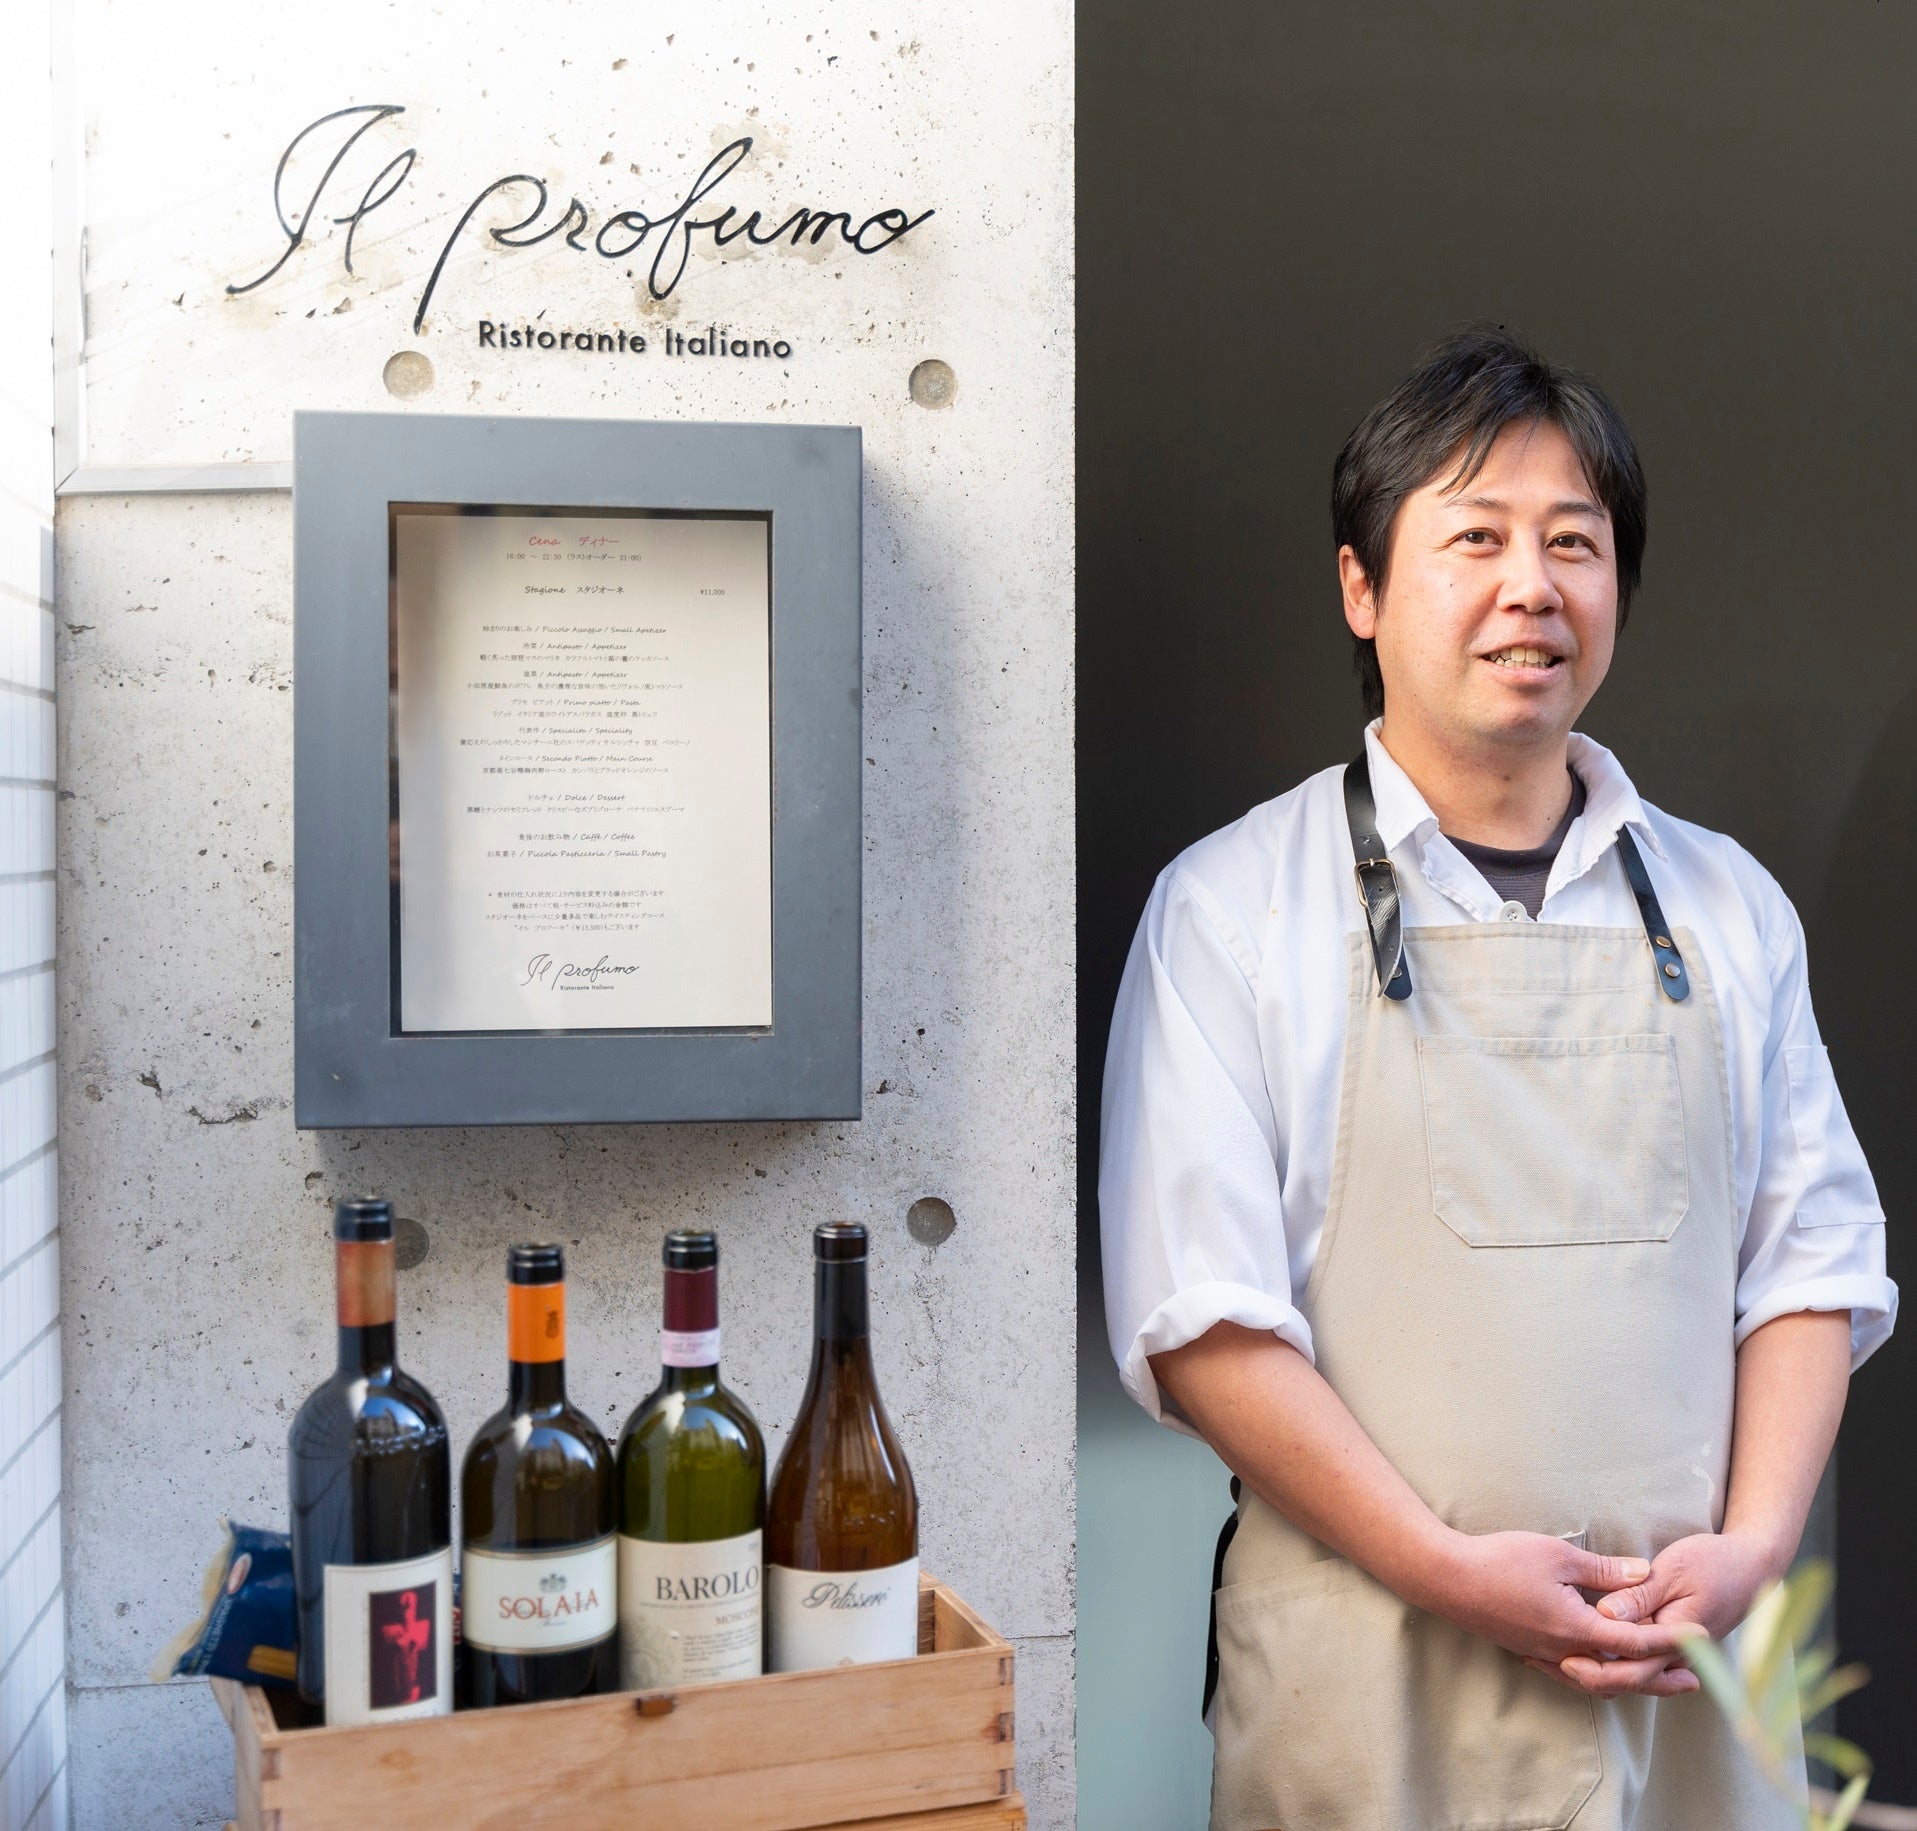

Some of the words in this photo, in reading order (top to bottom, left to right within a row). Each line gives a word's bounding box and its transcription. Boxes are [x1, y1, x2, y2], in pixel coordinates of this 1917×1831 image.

[225, 103, 417, 296] Il
[413, 136, 937, 335] profumo
[478, 320, 646, 355] Ristorante
[664, 324, 794, 358] Italiano
[529, 536, 561, 546] Cena
[579, 536, 619, 548] ディナー
[525, 586, 566, 595] Stagione
[576, 586, 624, 594] スタジオーネ
[609, 626, 634, 634] Small
[591, 672, 628, 680] Appetizer
[605, 754, 628, 762] Main
[596, 793, 626, 801] Dessert
[611, 833, 636, 842] Coffee
[528, 848, 559, 857] Piccola
[560, 848, 607, 858] Pasticceria
[613, 848, 641, 857] Small
[640, 850, 666, 858] Pastry
[521, 953, 553, 987] Il
[551, 954, 640, 991] profumo
[656, 1566, 759, 1601] BAROLO
[499, 1588, 599, 1620] SOLAIA
